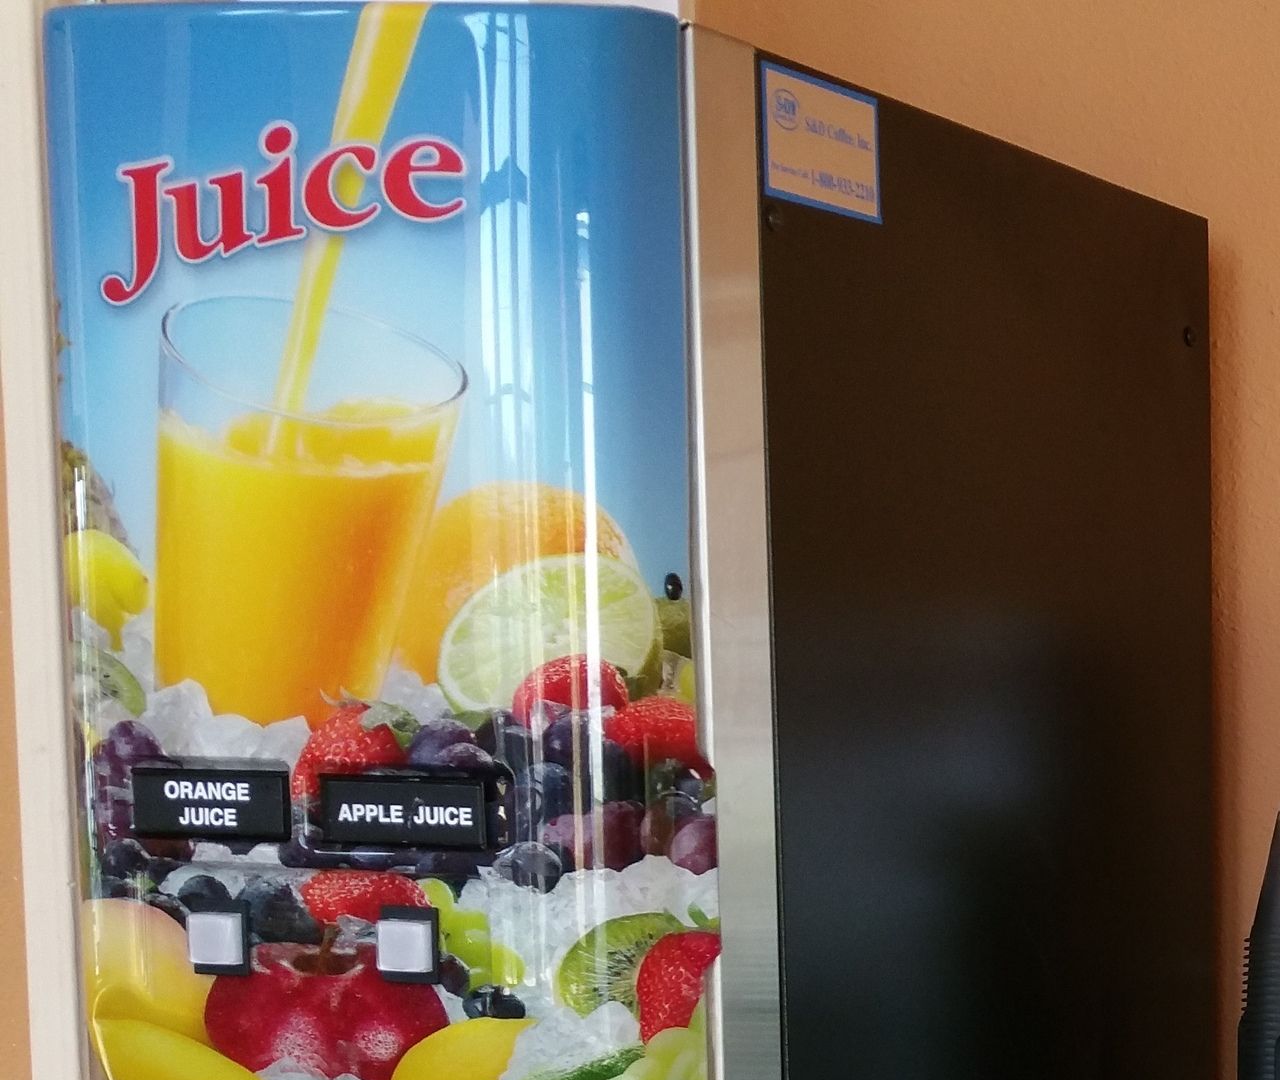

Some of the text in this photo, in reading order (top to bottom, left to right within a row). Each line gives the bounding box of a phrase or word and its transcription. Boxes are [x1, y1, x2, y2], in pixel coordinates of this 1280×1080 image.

[103, 126, 464, 302] Juice
[164, 780, 250, 801] ORANGE
[178, 807, 238, 827] JUICE
[338, 803, 474, 826] APPLE JUICE
